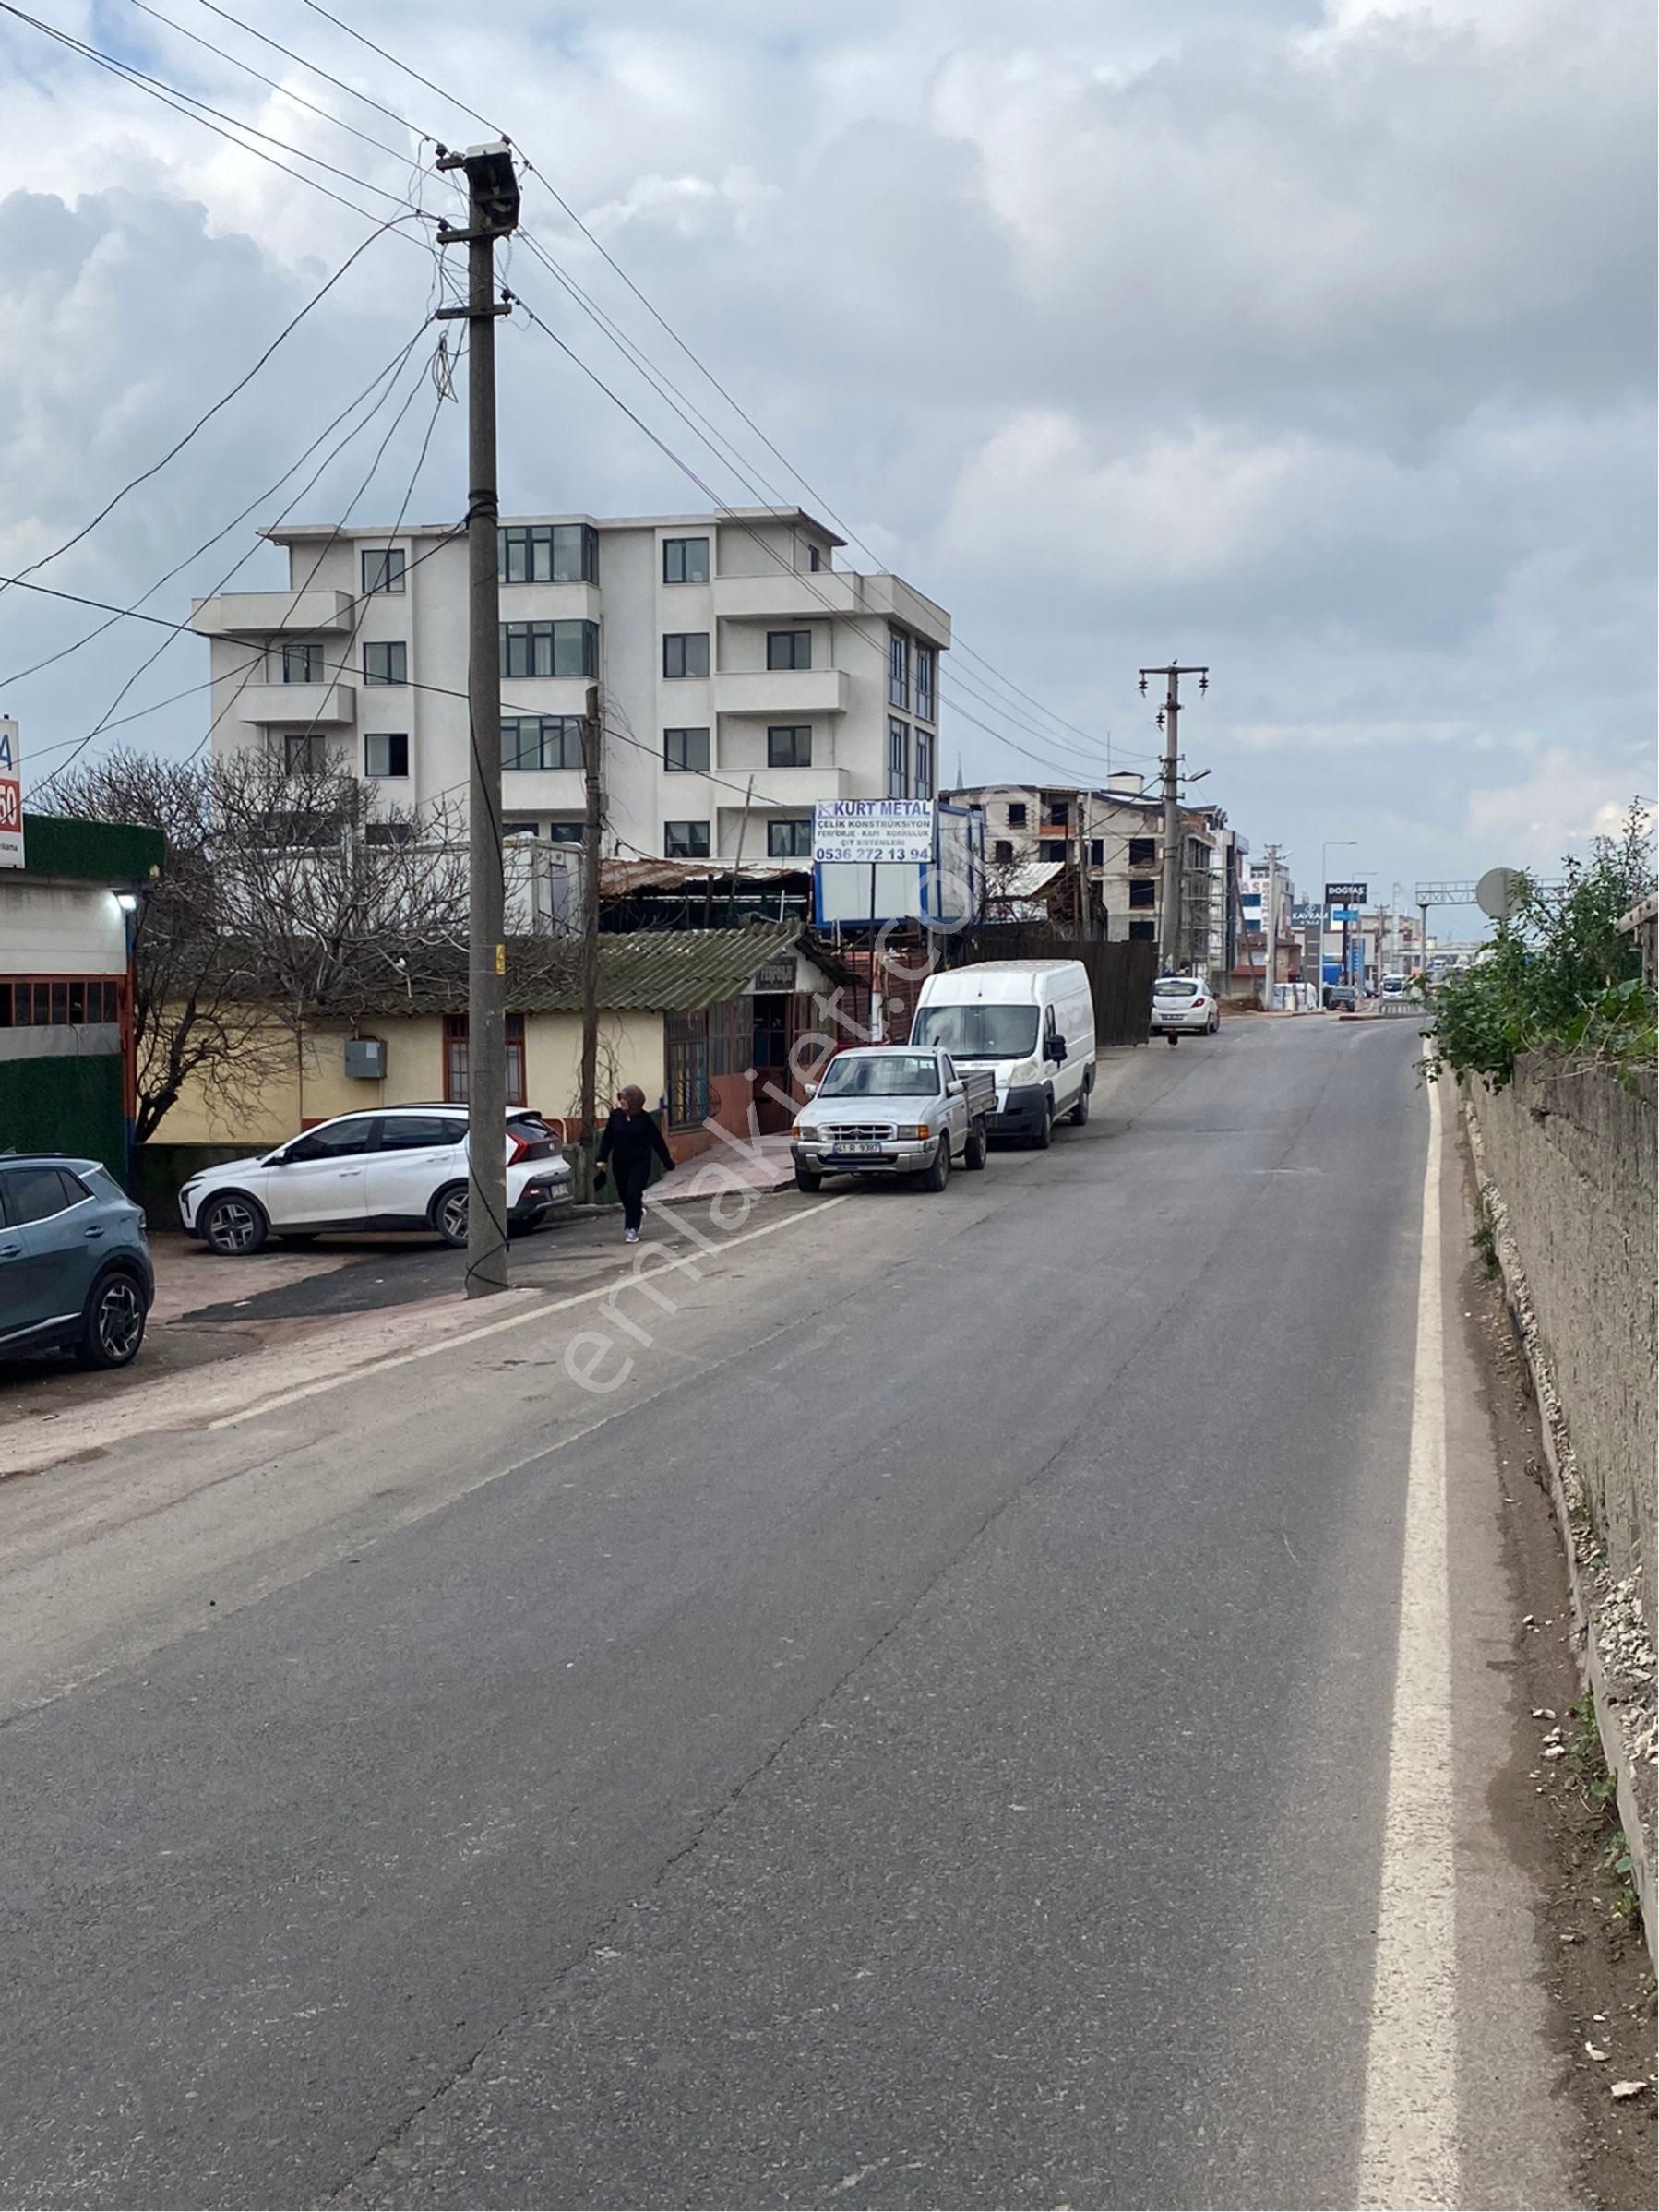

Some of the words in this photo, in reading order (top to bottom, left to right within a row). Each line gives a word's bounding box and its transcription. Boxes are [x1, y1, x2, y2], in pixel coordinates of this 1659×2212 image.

[834, 802, 876, 816] KURT
[880, 802, 930, 815] METAL
[818, 819, 845, 829] ÇELİK
[817, 848, 852, 860] 0536
[856, 848, 883, 860] 272
[889, 848, 905, 860] 13
[910, 848, 928, 860] 94
